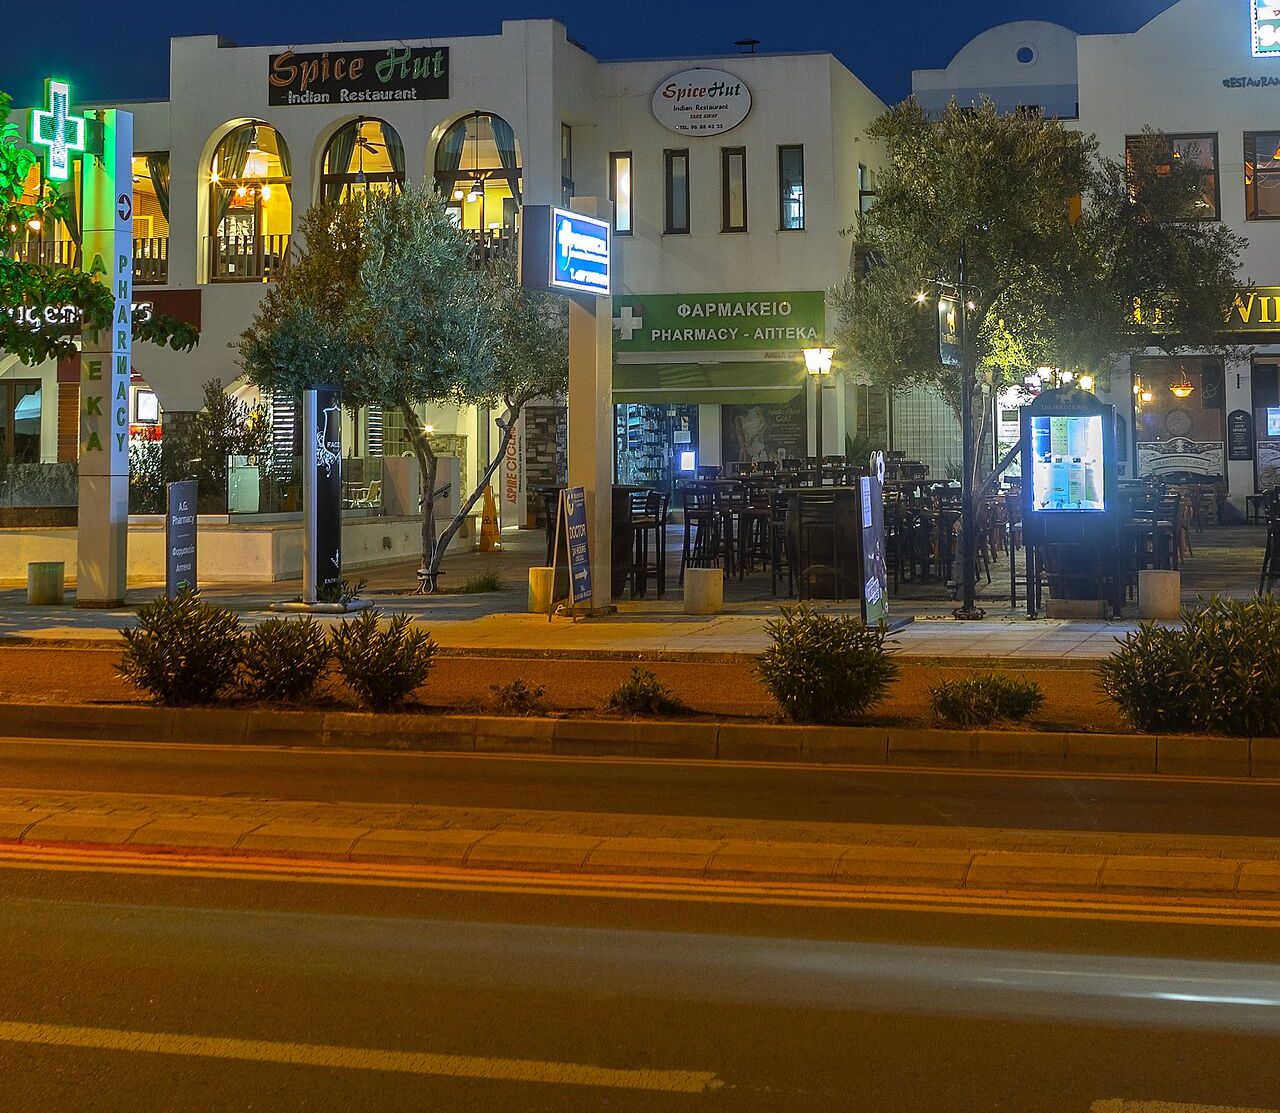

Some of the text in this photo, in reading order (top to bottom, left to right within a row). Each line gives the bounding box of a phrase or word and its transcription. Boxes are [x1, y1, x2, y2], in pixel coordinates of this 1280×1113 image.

[270, 45, 445, 92] Spice Hut
[287, 87, 418, 104] Indian Restaurant
[662, 81, 741, 102] Spice Hut
[673, 103, 729, 112] Indian Restaurant
[677, 301, 792, 318] ΦΑΡΜΑΚΕΙΟ
[651, 327, 739, 342] PHARMACY
[115, 254, 128, 452] PHARMACY
[506, 473, 517, 504] ASPIRE
[172, 513, 195, 526] Pharmacy
[570, 523, 587, 540] DOCTOR
